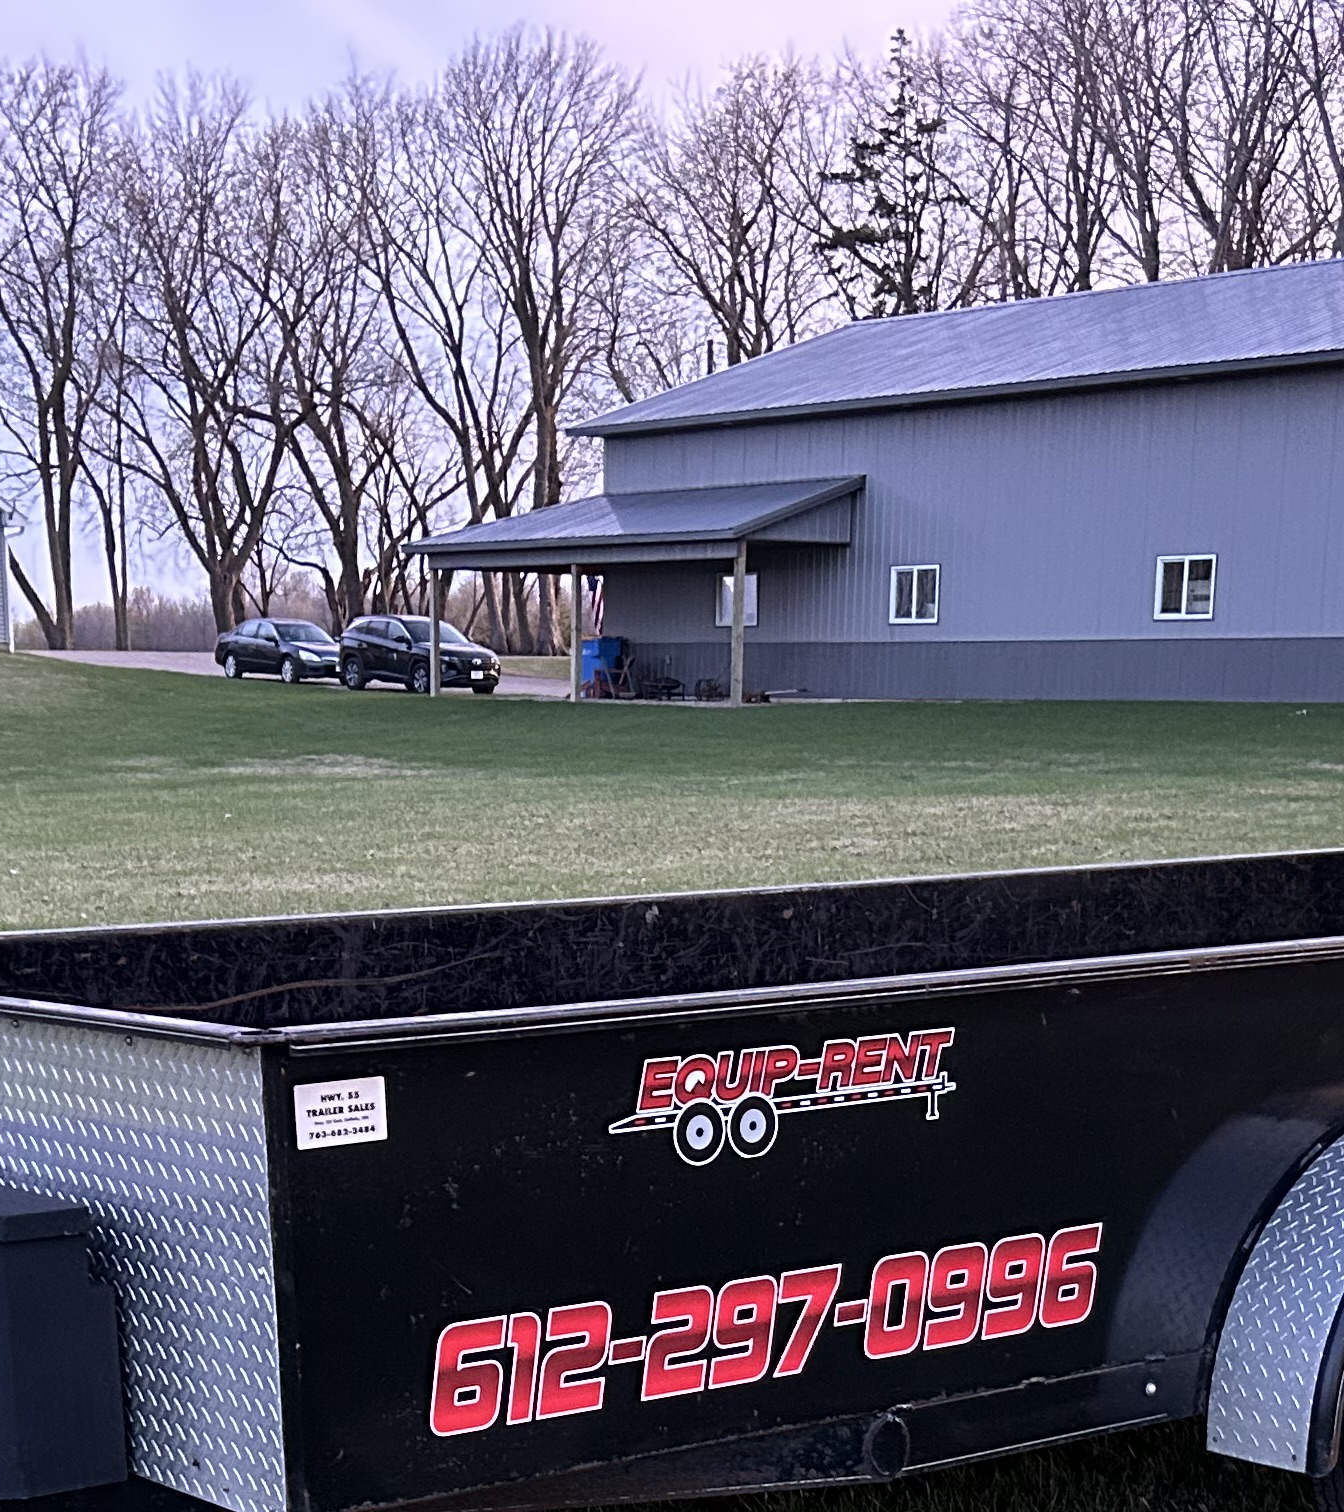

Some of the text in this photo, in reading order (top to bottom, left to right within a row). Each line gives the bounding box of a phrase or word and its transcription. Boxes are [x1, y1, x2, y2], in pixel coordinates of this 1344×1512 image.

[347, 1090, 360, 1100] 55
[636, 1026, 956, 1114] EQUIP-RENT
[306, 1102, 376, 1118] TRAILER SALES
[428, 1222, 1104, 1437] 612-297-0996
